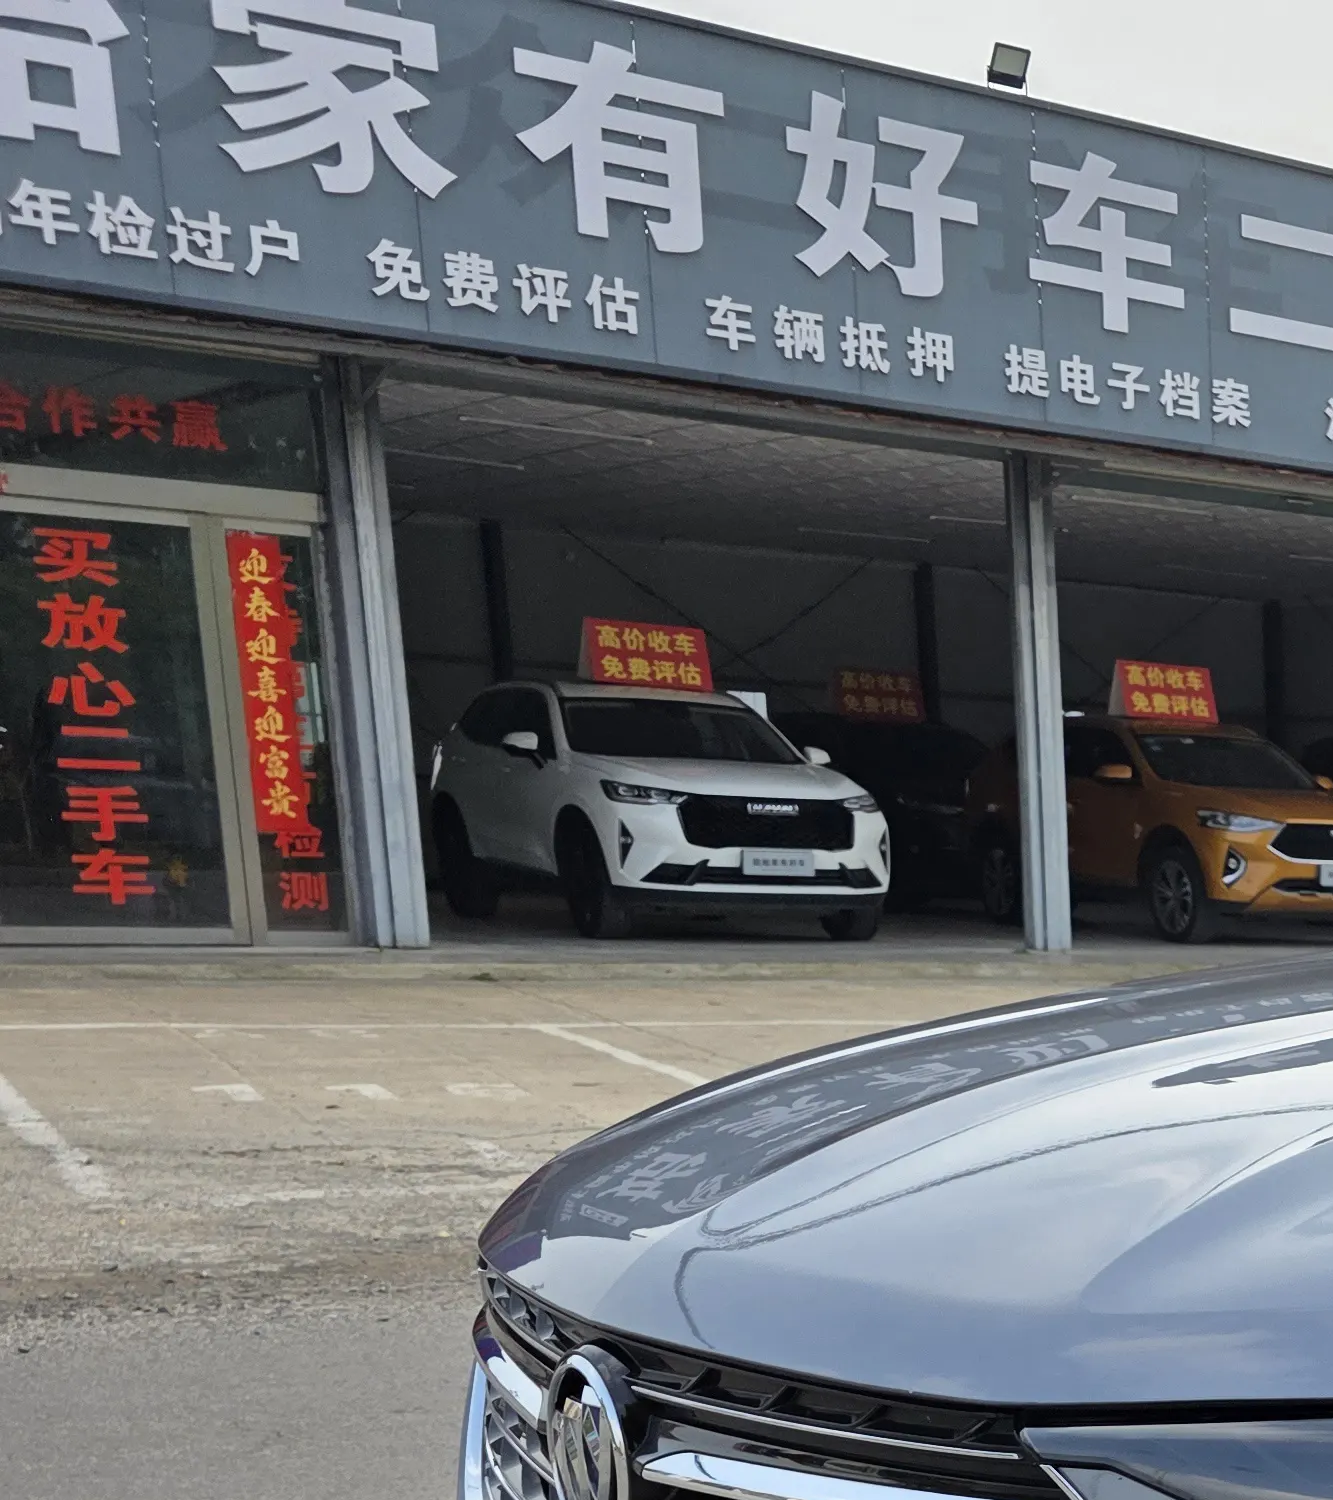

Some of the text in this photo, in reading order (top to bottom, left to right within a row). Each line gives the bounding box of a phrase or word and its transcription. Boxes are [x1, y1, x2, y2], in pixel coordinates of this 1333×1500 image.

[8, 178, 300, 276] 年检过户
[366, 238, 640, 335] 免费评估
[705, 295, 955, 382] 车辆抵押
[1004, 344, 1252, 428] 提电子档案
[595, 625, 698, 656] 高价收车
[239, 548, 299, 819] 迎春迎喜迎富贵
[601, 654, 702, 686] 免费评估
[1124, 665, 1205, 692] 高价收车
[33, 527, 156, 905] 买放心二手车
[1131, 690, 1210, 718] 免费评估
